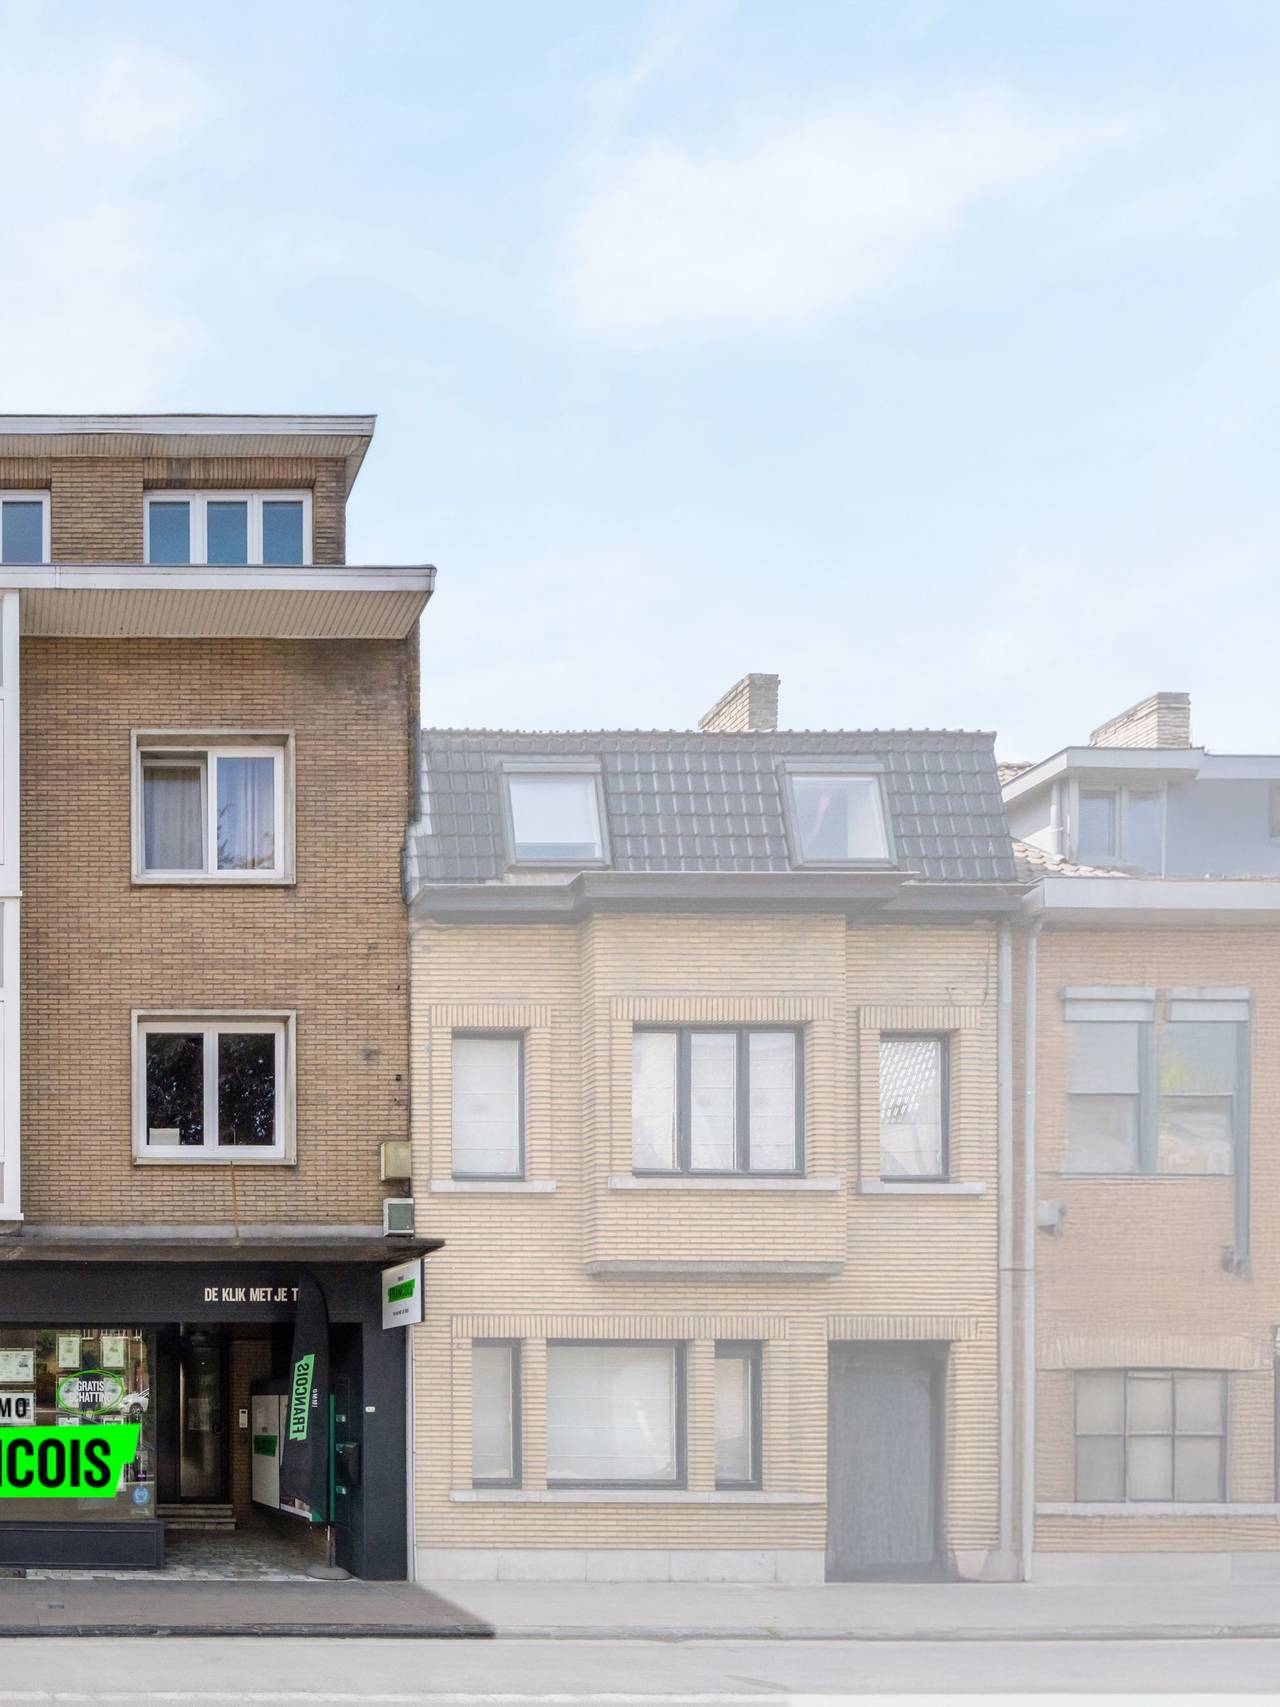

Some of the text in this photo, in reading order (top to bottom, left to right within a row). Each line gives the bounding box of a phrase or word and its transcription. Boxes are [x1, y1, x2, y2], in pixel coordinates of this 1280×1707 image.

[204, 1287, 219, 1302] DE
[222, 1287, 246, 1302] KLIK
[249, 1287, 273, 1302] MET
[274, 1287, 288, 1302] JE
[76, 1381, 105, 1392] GRATIS
